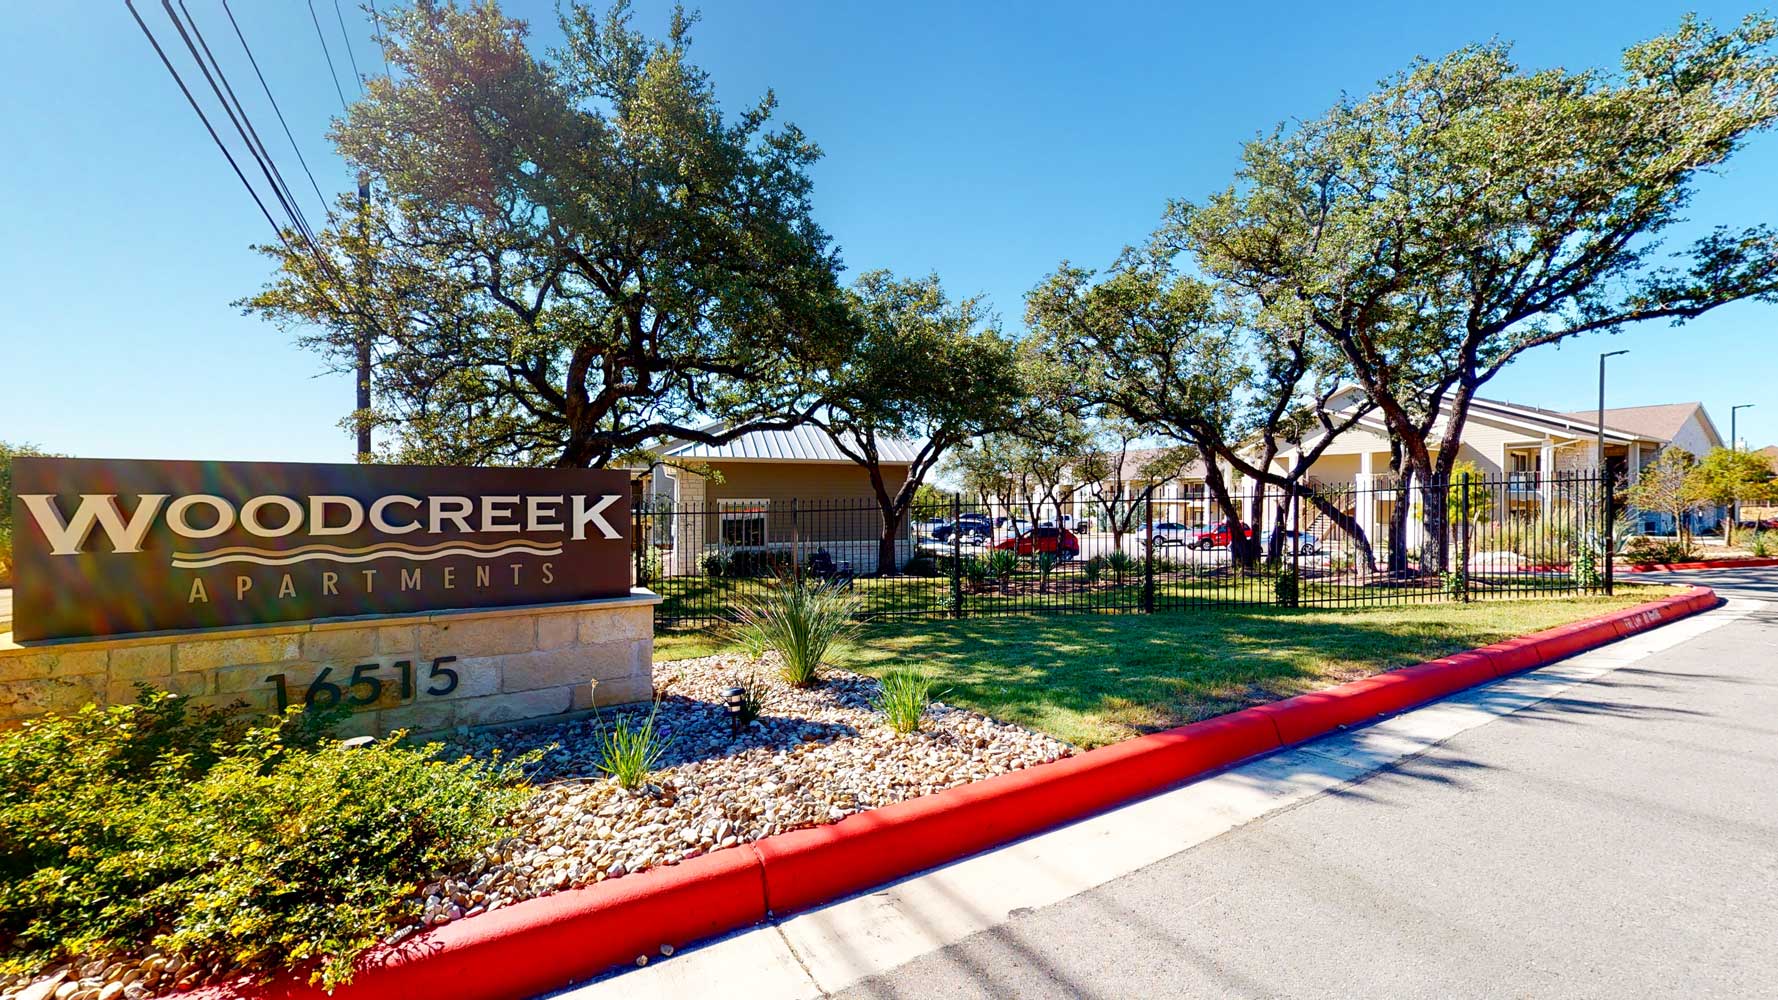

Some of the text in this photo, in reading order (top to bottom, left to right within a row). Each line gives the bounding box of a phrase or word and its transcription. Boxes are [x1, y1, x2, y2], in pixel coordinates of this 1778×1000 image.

[17, 494, 624, 556] WOODCREEK
[188, 562, 555, 603] APARTMENTS
[265, 655, 459, 716] 16515
